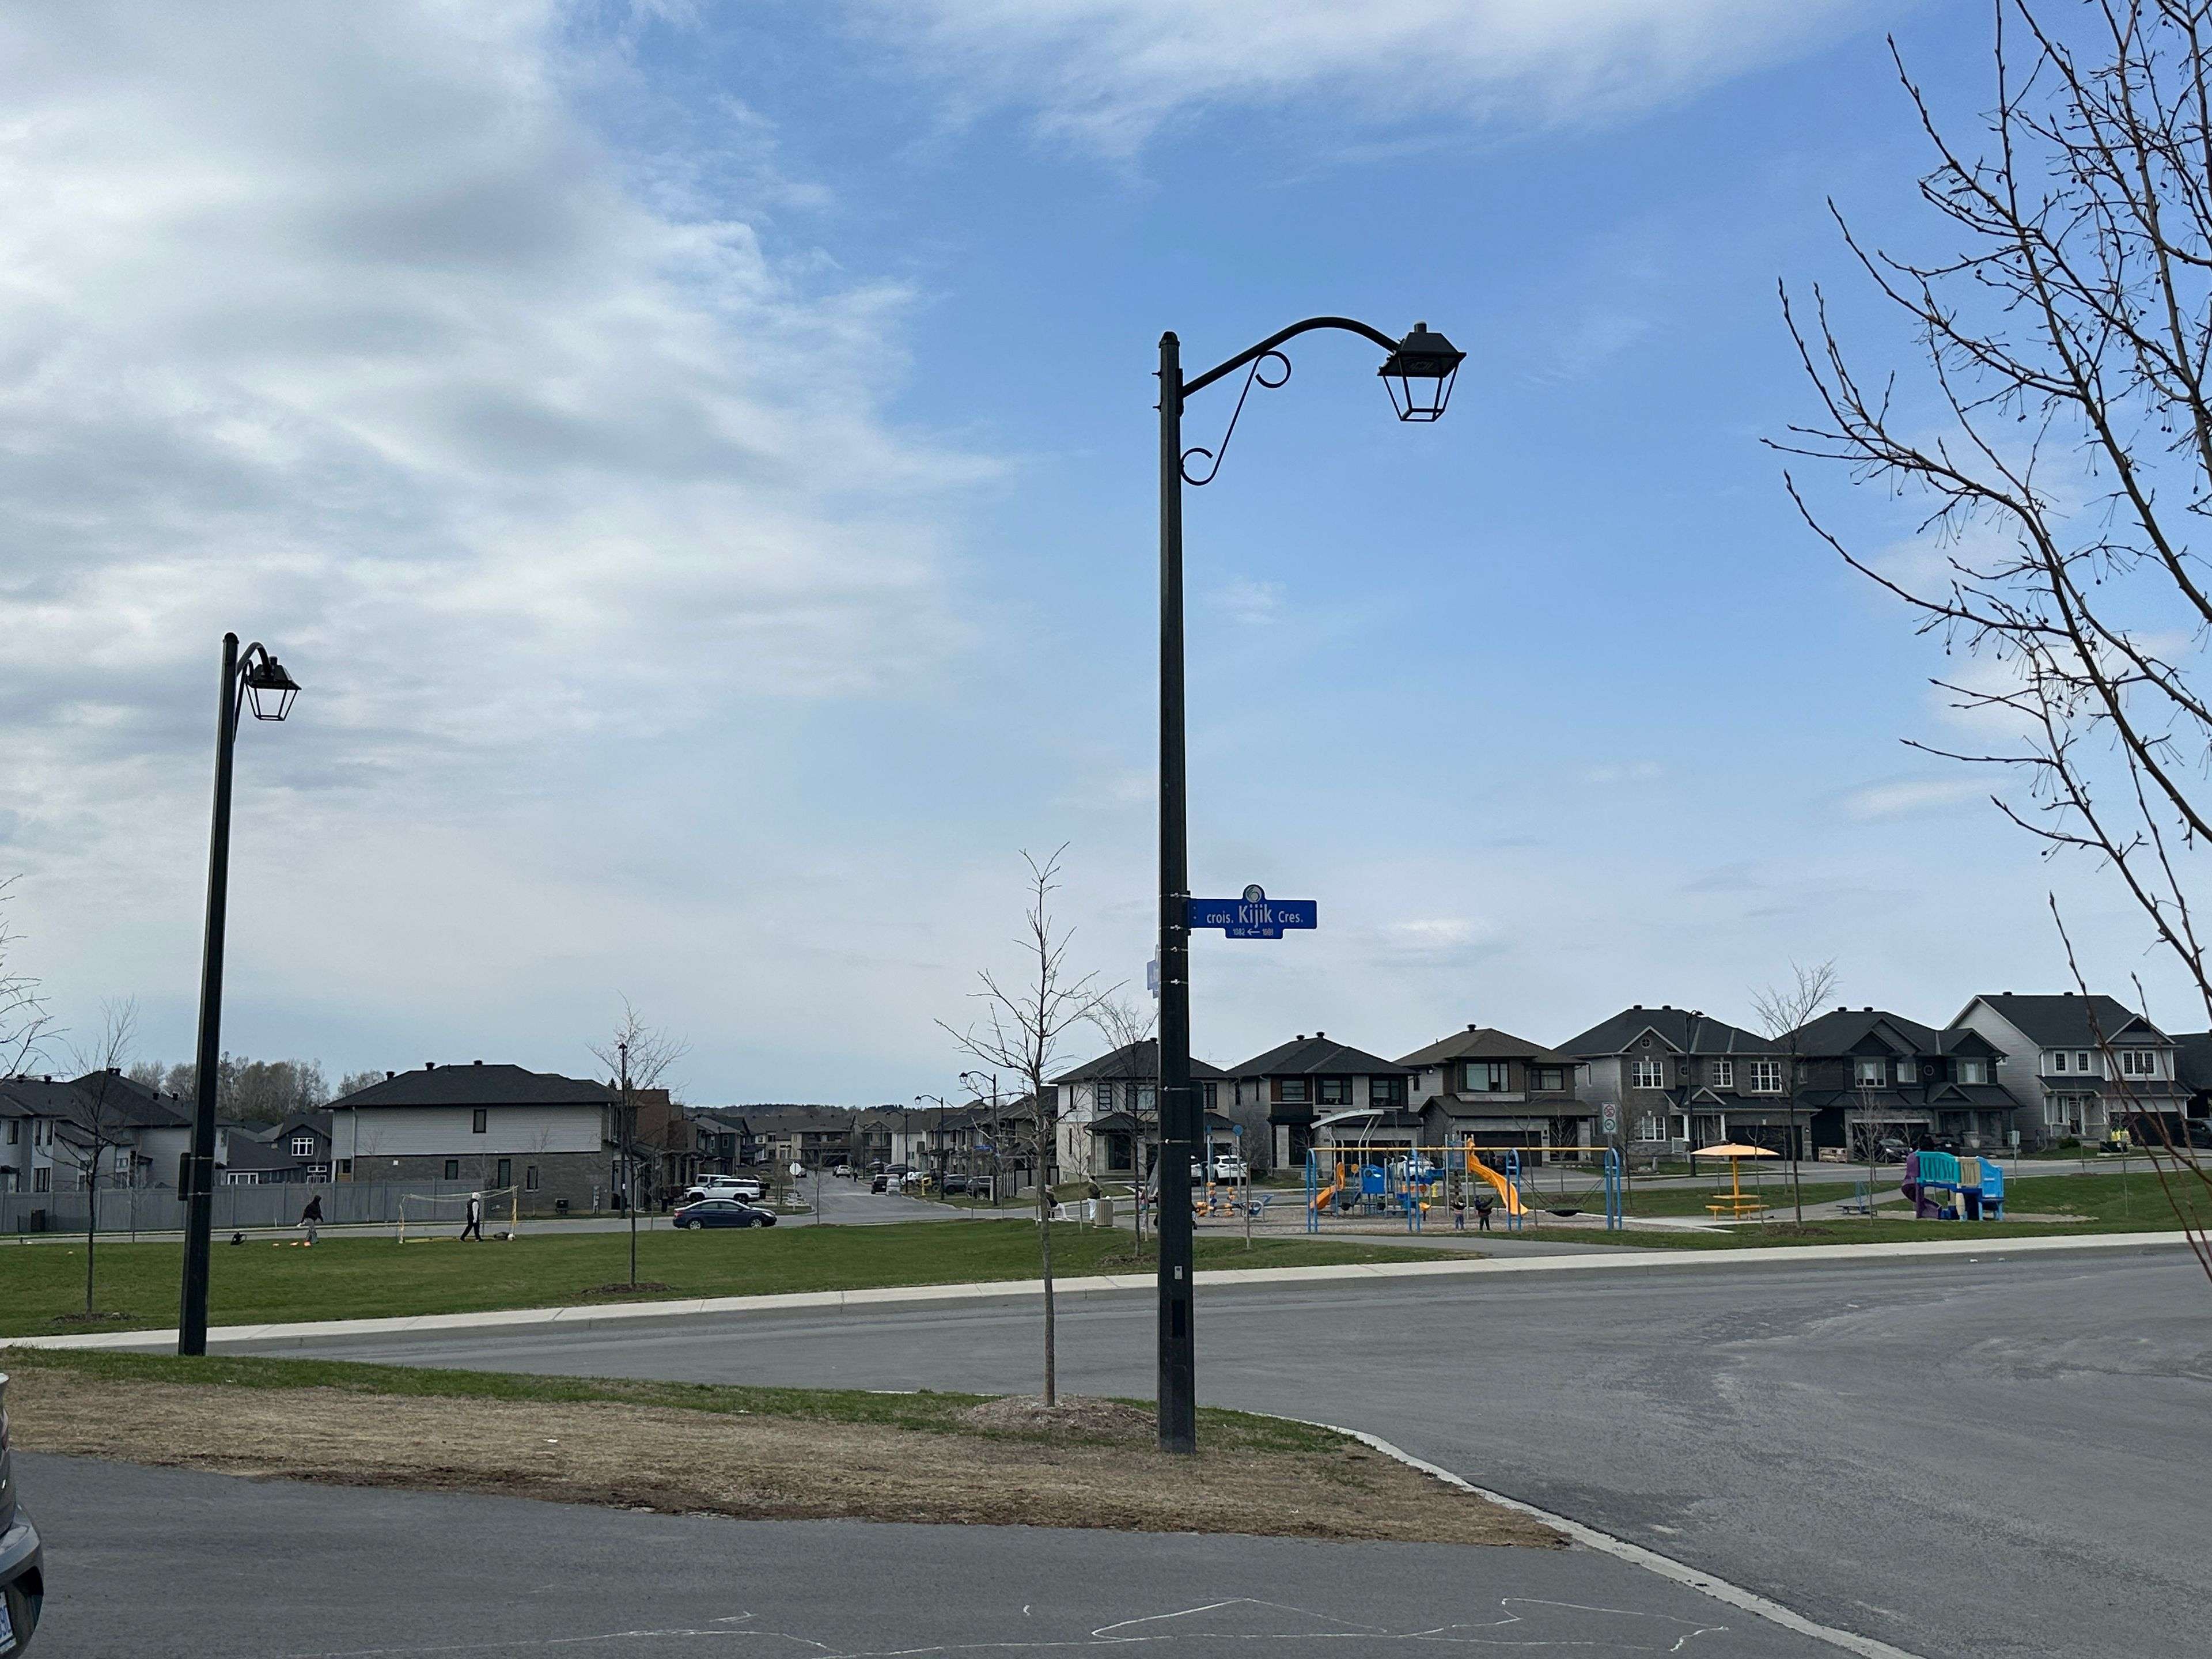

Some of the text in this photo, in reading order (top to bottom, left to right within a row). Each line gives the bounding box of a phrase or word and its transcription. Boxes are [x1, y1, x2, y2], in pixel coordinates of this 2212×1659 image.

[1206, 903, 1304, 928] crois. Kijik Cres.
